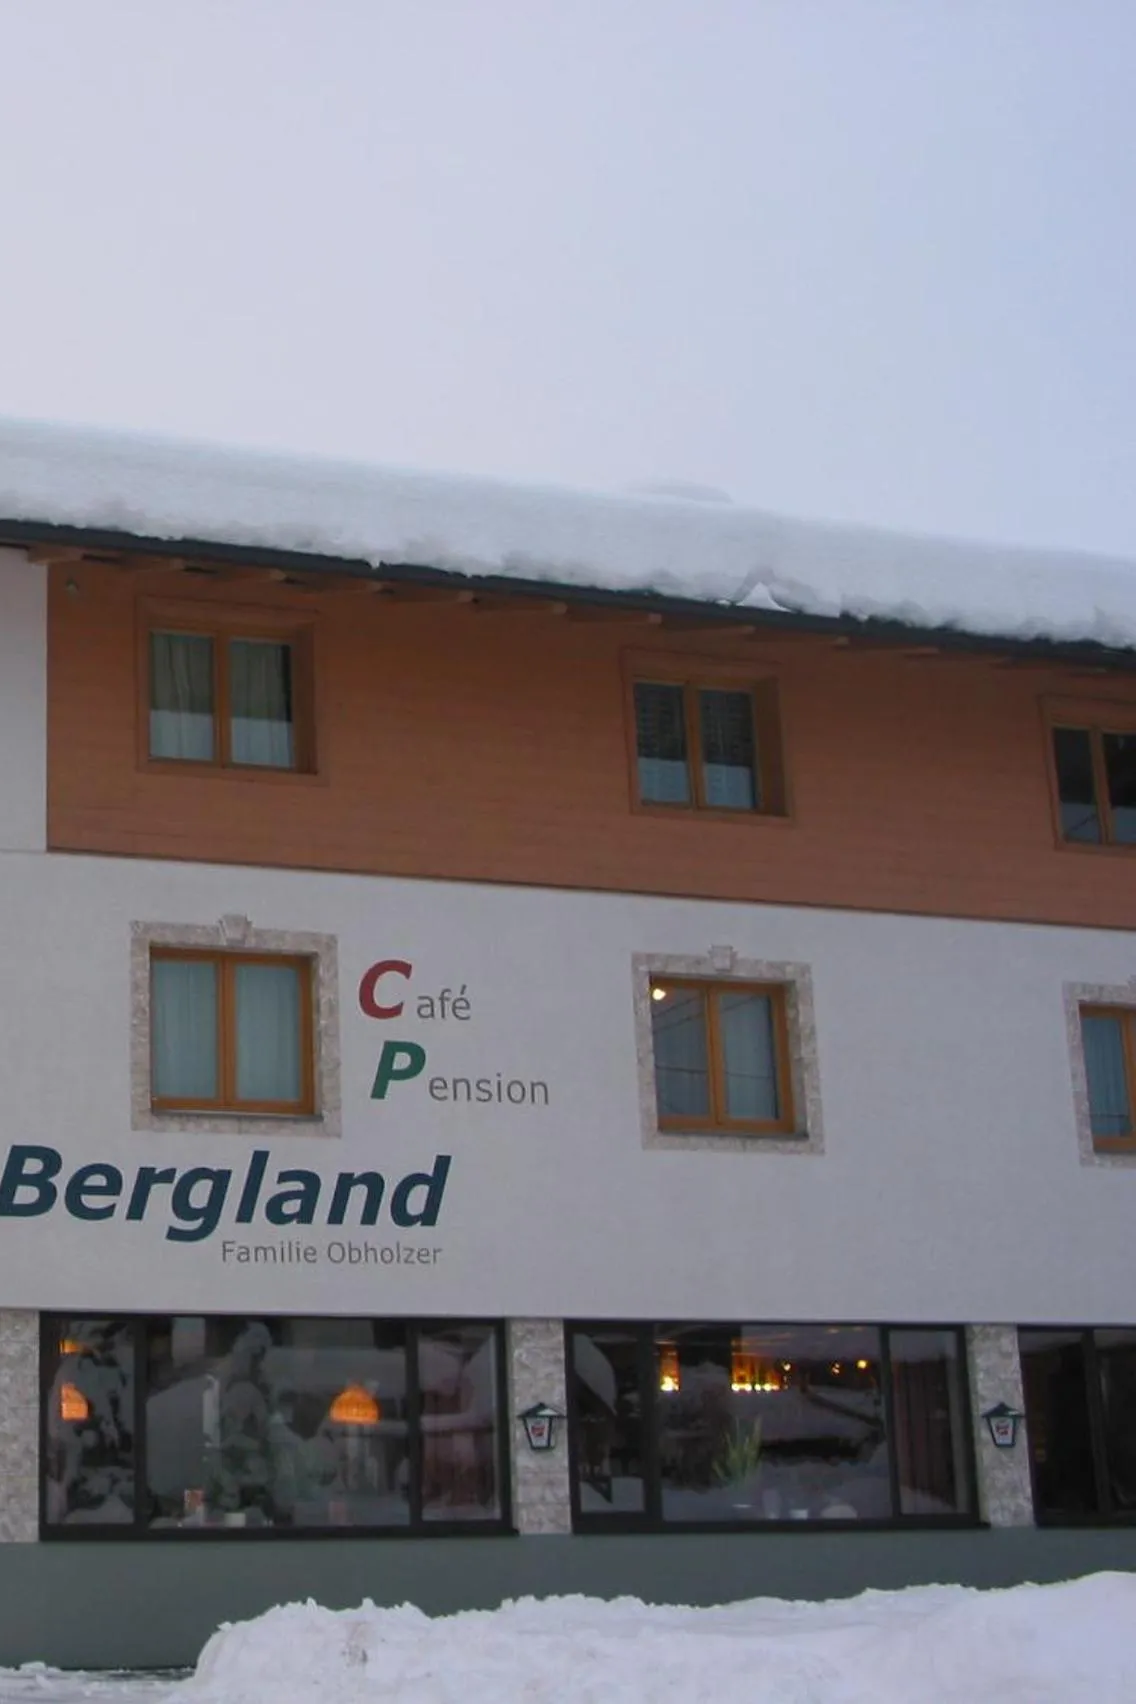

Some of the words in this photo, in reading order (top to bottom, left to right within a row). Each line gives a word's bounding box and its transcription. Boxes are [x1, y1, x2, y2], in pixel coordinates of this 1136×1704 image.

[358, 958, 471, 1021] Café
[369, 1039, 549, 1106] Pension
[221, 1240, 318, 1264] Familie
[326, 1240, 443, 1265] Obholzer
